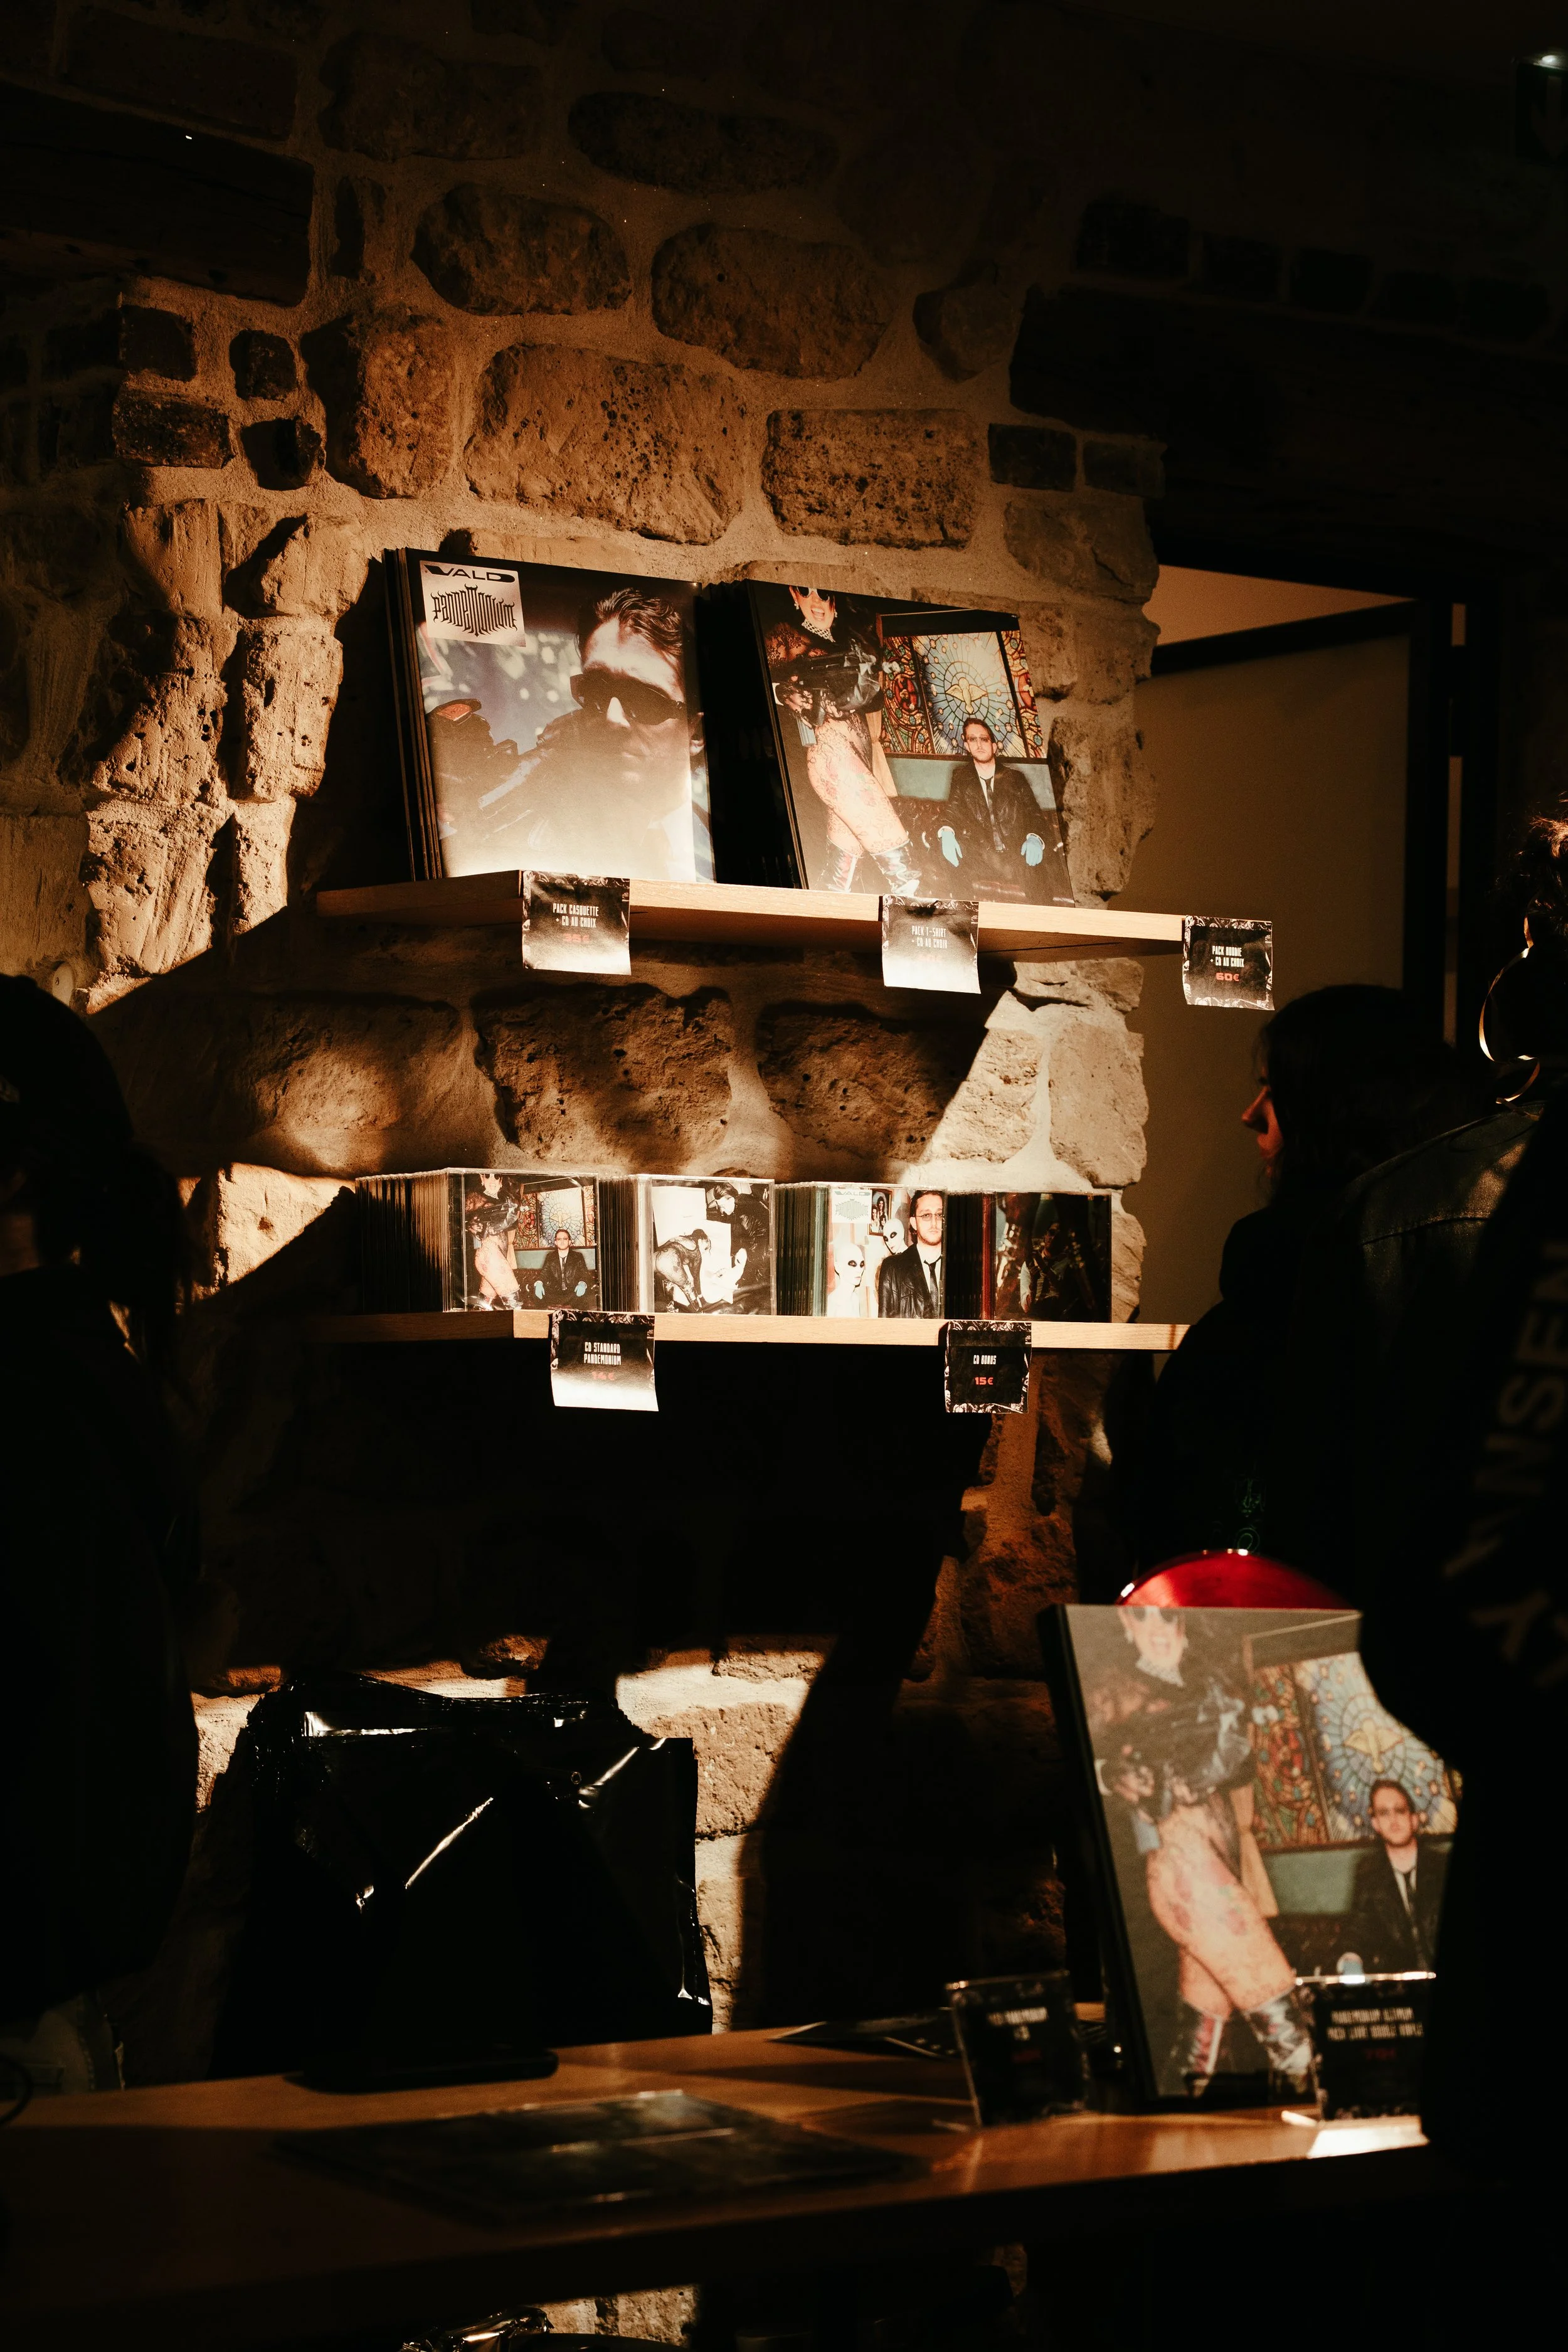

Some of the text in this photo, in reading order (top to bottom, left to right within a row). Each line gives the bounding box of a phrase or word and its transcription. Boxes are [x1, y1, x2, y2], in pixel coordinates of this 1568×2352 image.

[424, 564, 515, 583] VALD
[553, 903, 599, 916] PACK CASQUETTE
[562, 916, 569, 926] CD
[571, 916, 578, 927] AU
[580, 917, 596, 928] CHOIX
[911, 925, 946, 938] PACK T-SHIRT
[925, 939, 931, 948] AU
[1212, 945, 1224, 956] PACK
[1223, 957, 1229, 967] AU
[1231, 958, 1244, 968] CHOIX
[1216, 972, 1240, 982] 60€
[585, 1342, 620, 1353] CD STANDARD
[584, 1353, 622, 1365] PANDEMONIUM
[973, 1355, 997, 1365] CD BONUS
[975, 1377, 993, 1385] 15€
